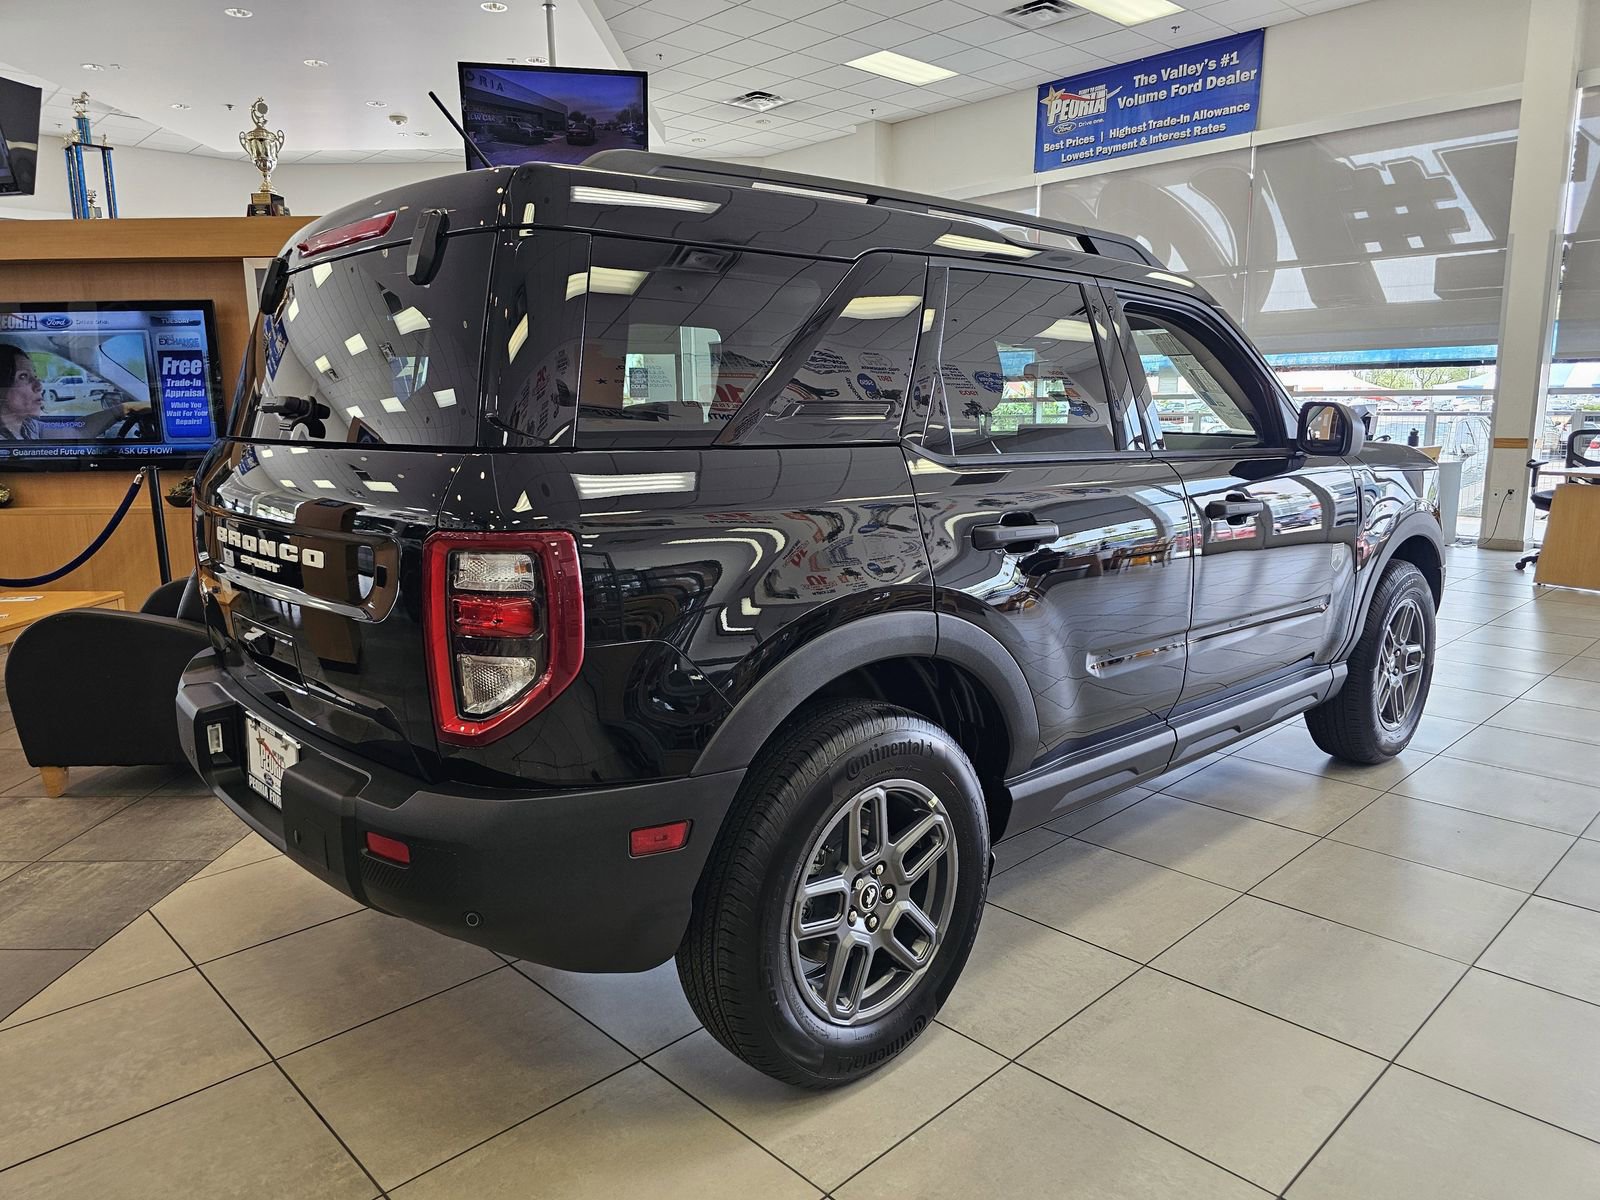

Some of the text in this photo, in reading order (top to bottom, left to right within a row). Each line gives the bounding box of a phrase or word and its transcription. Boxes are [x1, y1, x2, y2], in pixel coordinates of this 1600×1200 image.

[1134, 51, 1240, 88] The Valley's #1
[1118, 68, 1258, 110] Volume Ford Dealer
[1048, 90, 1107, 126] PEORIA
[1078, 120, 1092, 128] Drive
[1044, 142, 1064, 152] Best
[1066, 134, 1095, 148] Prices
[1109, 122, 1148, 139] Highest
[1148, 114, 1192, 130] Trade-In
[1192, 102, 1250, 122] Allowance
[1060, 121, 1226, 163] Lowest Payment & Interest Rates
[162, 356, 202, 375] Free
[166, 378, 202, 387] Trade-In
[165, 389, 205, 398] Appraisal
[12, 448, 58, 456] Guaranteed
[216, 526, 324, 569] BRONCO
[240, 554, 280, 573] SPORT
[846, 739, 924, 781] Continental
[847, 1014, 927, 1073] Continental
